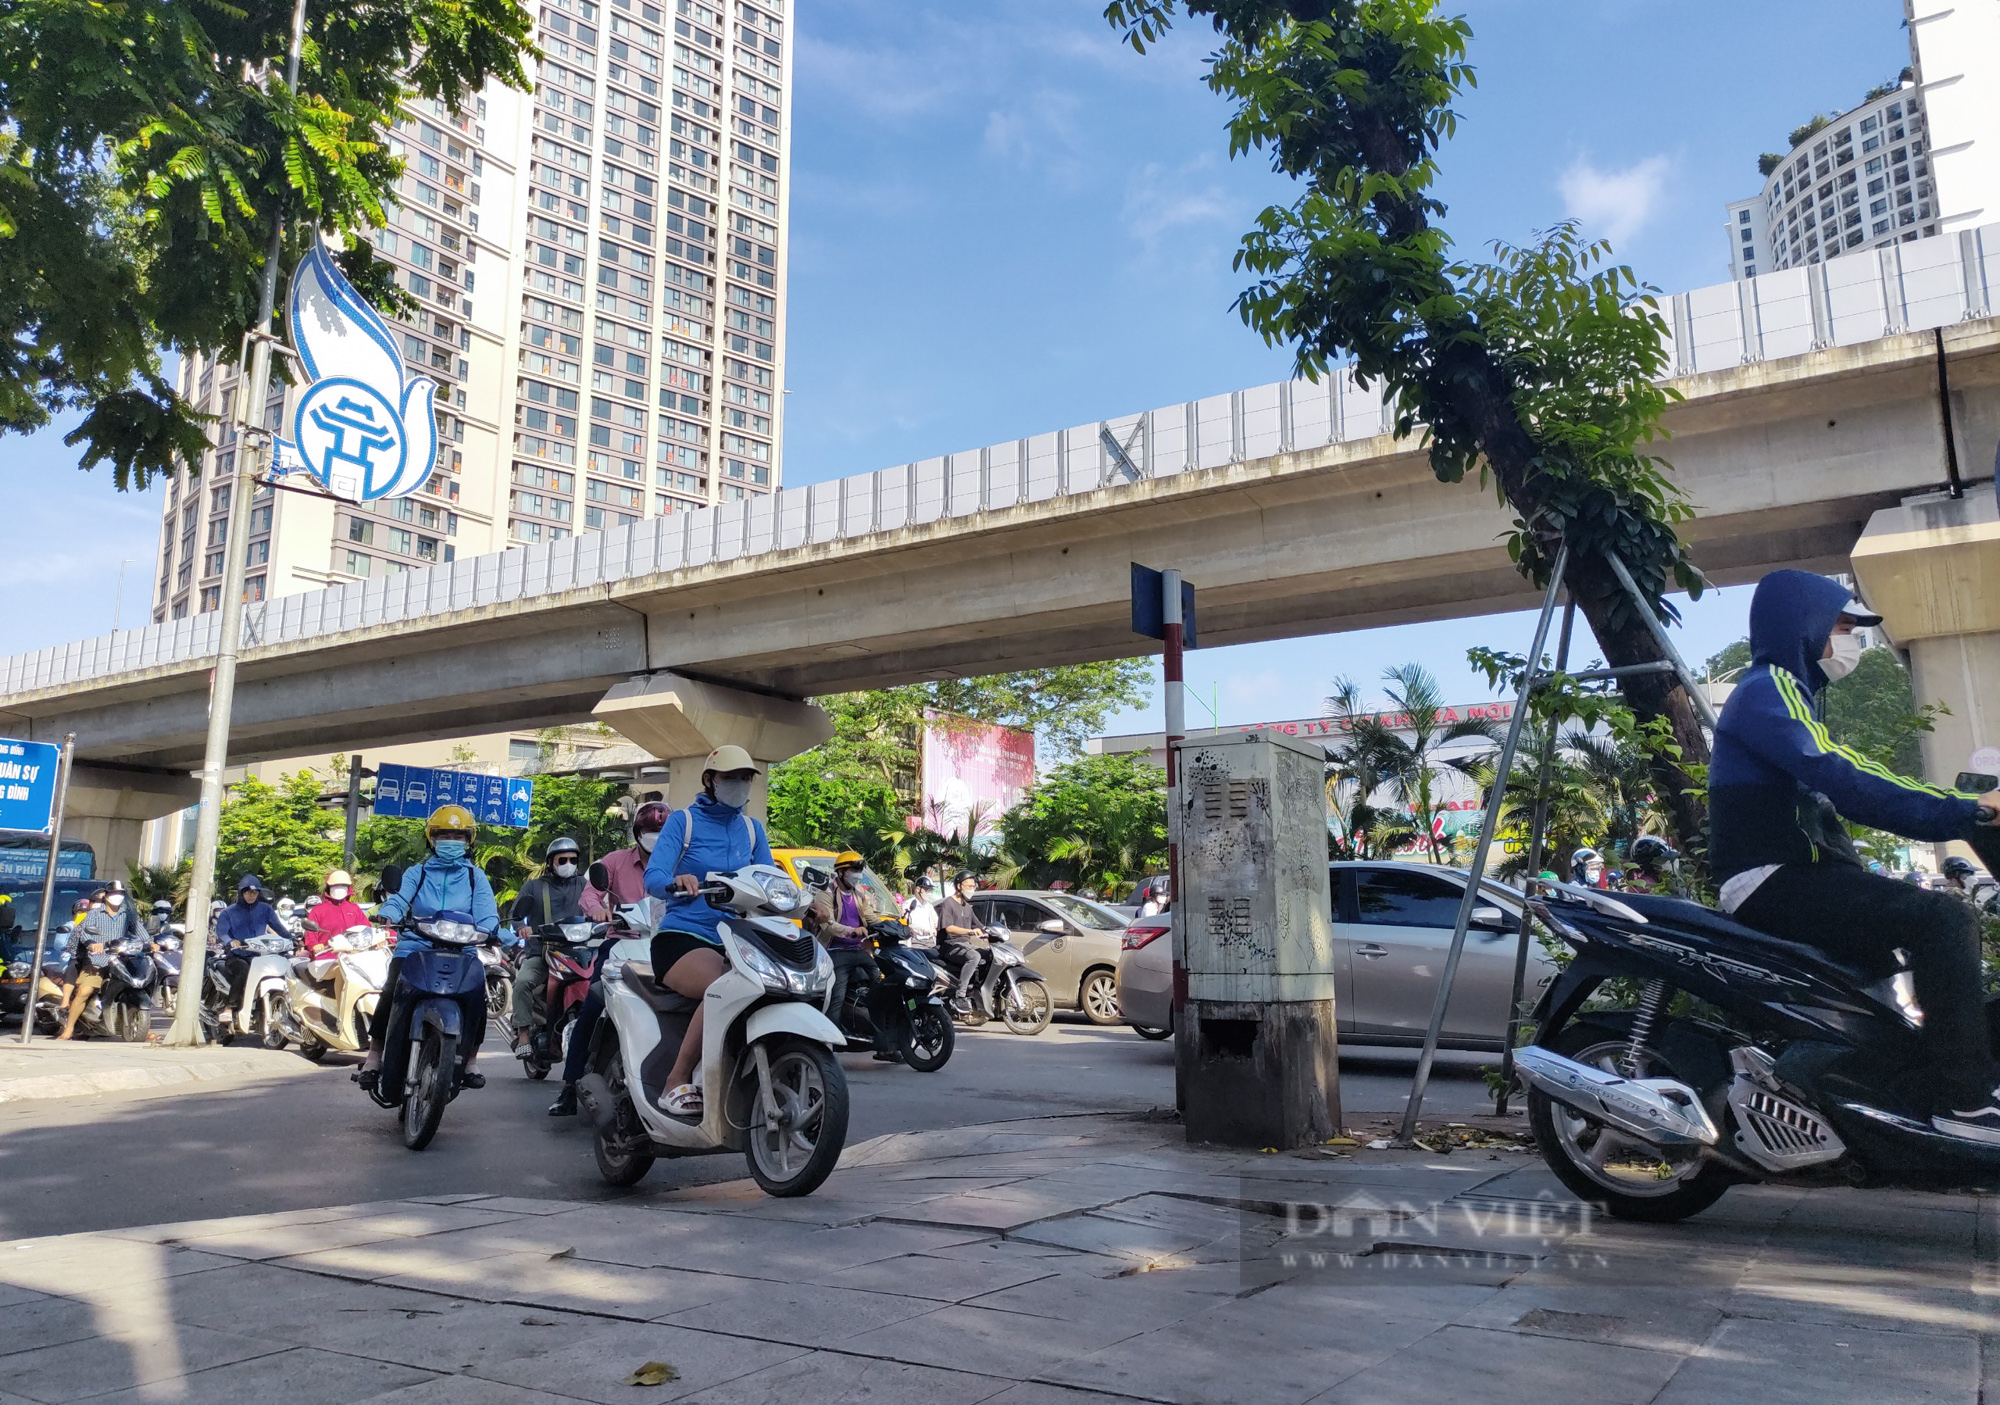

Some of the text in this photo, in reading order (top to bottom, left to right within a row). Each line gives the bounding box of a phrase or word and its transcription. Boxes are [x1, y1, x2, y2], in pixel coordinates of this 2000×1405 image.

[1304, 719, 1331, 735] TY
[1379, 711, 1418, 727] KH
[1467, 702, 1512, 721] NỘI
[22, 765, 40, 783] SỰ
[7, 783, 29, 801] ĐÌNH
[15, 864, 44, 876] PHÁT
